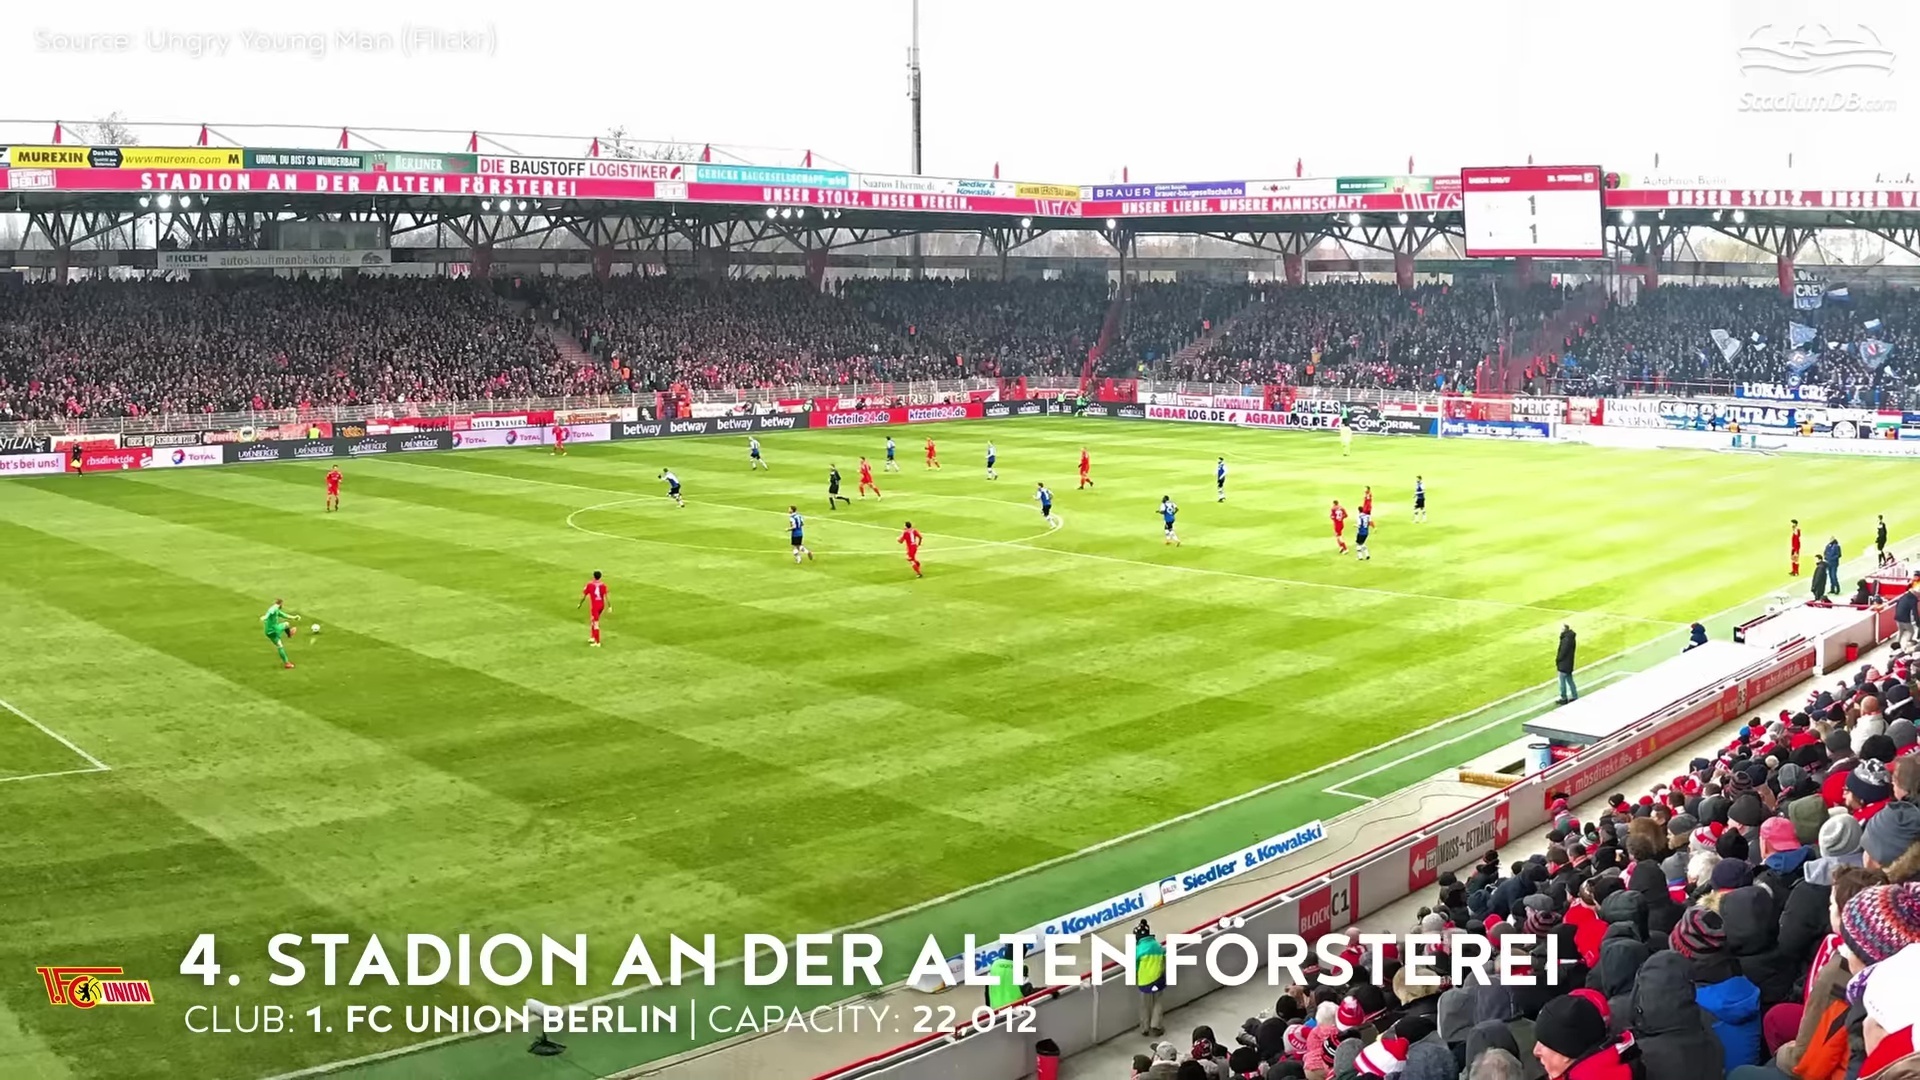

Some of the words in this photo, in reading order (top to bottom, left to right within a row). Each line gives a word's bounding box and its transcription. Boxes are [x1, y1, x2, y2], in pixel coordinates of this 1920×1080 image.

[18, 152, 83, 163] MUREXIN
[125, 155, 222, 165] www.murexin.com
[228, 154, 239, 164] M
[280, 155, 289, 165] DU
[291, 155, 306, 165] BIST
[317, 156, 360, 168] WUNDERBAR!
[480, 159, 505, 173] DIE
[510, 160, 586, 176] BAUSTOFF
[589, 163, 668, 179] LOGISTIKER
[141, 173, 250, 190] STADION
[267, 174, 297, 190] AN
[316, 175, 360, 191] DER
[376, 176, 444, 193] ALTEN
[460, 176, 576, 196] FÖRSTEREI
[763, 188, 809, 202] UNSER
[818, 190, 865, 205] STOLZ.
[872, 193, 915, 207] UNSER
[921, 195, 973, 210] VEREIN.
[1096, 187, 1151, 198] BRAUER
[1668, 190, 1731, 206] UNSER
[1742, 190, 1812, 207] STOLZ.
[1821, 191, 1888, 207] UNSER
[1122, 201, 1167, 215] UNSERE
[1173, 200, 1213, 213] LIEBE.
[1220, 198, 1268, 212] UNSERE
[1272, 195, 1368, 211] MANNSCHAFT.
[174, 254, 208, 263] KOCH
[827, 412, 890, 425] kfzteile24.de
[909, 407, 967, 420] kfzteile24.de
[1149, 407, 1226, 421] AGRARLOG.DE
[670, 421, 707, 433] betway
[717, 418, 753, 431] betway
[760, 415, 796, 428] betway
[623, 423, 662, 435] betway
[20, 459, 35, 469] bei
[38, 458, 59, 468] uns!
[188, 453, 216, 461] TOTAL
[1183, 860, 1238, 891] Siedler
[1244, 852, 1257, 867] &
[1257, 824, 1323, 863] Kowalski
[1331, 889, 1350, 917] C1
[1061, 893, 1145, 935] Kowalski
[1300, 905, 1331, 934] BLOCK
